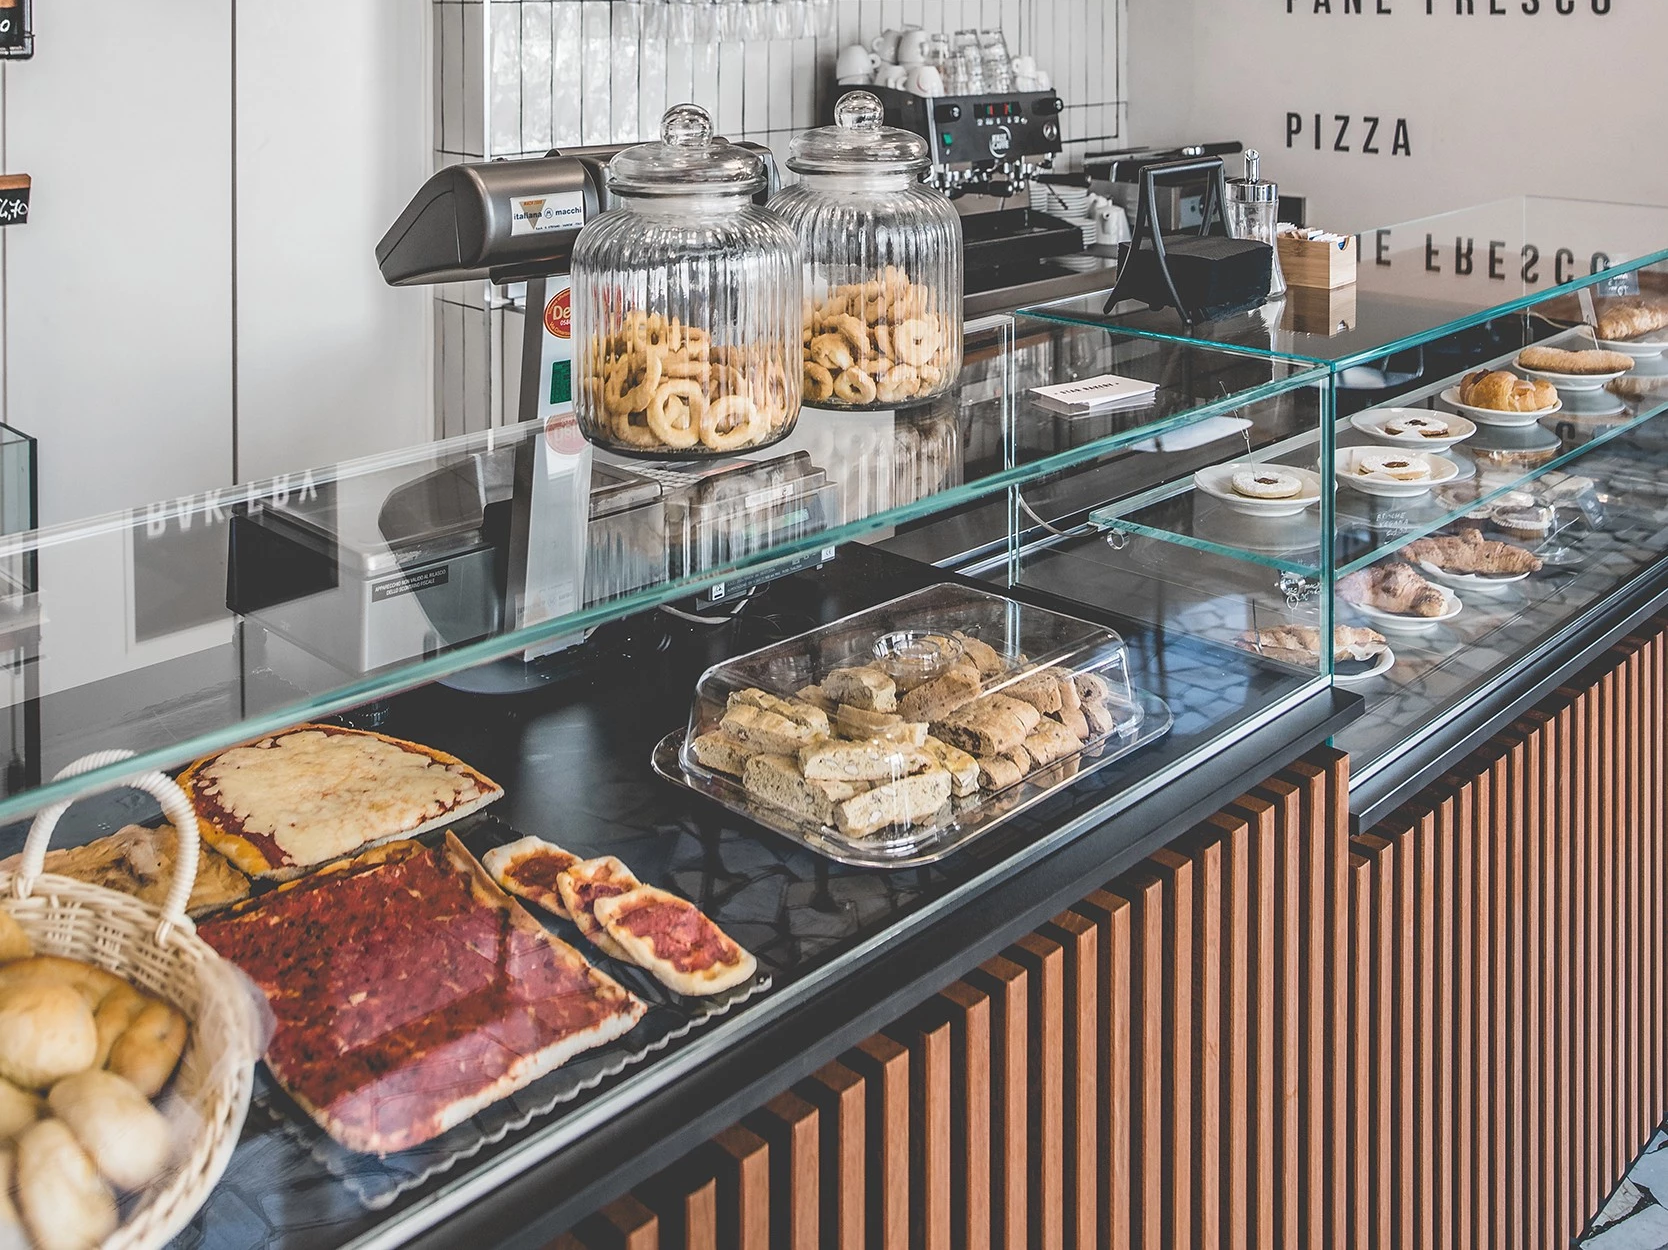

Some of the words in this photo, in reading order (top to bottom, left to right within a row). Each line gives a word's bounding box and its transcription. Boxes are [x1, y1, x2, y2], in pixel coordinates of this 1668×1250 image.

[1286, 112, 1412, 157] PIZZA
[513, 211, 543, 221] italiana
[555, 206, 582, 216] macchi
